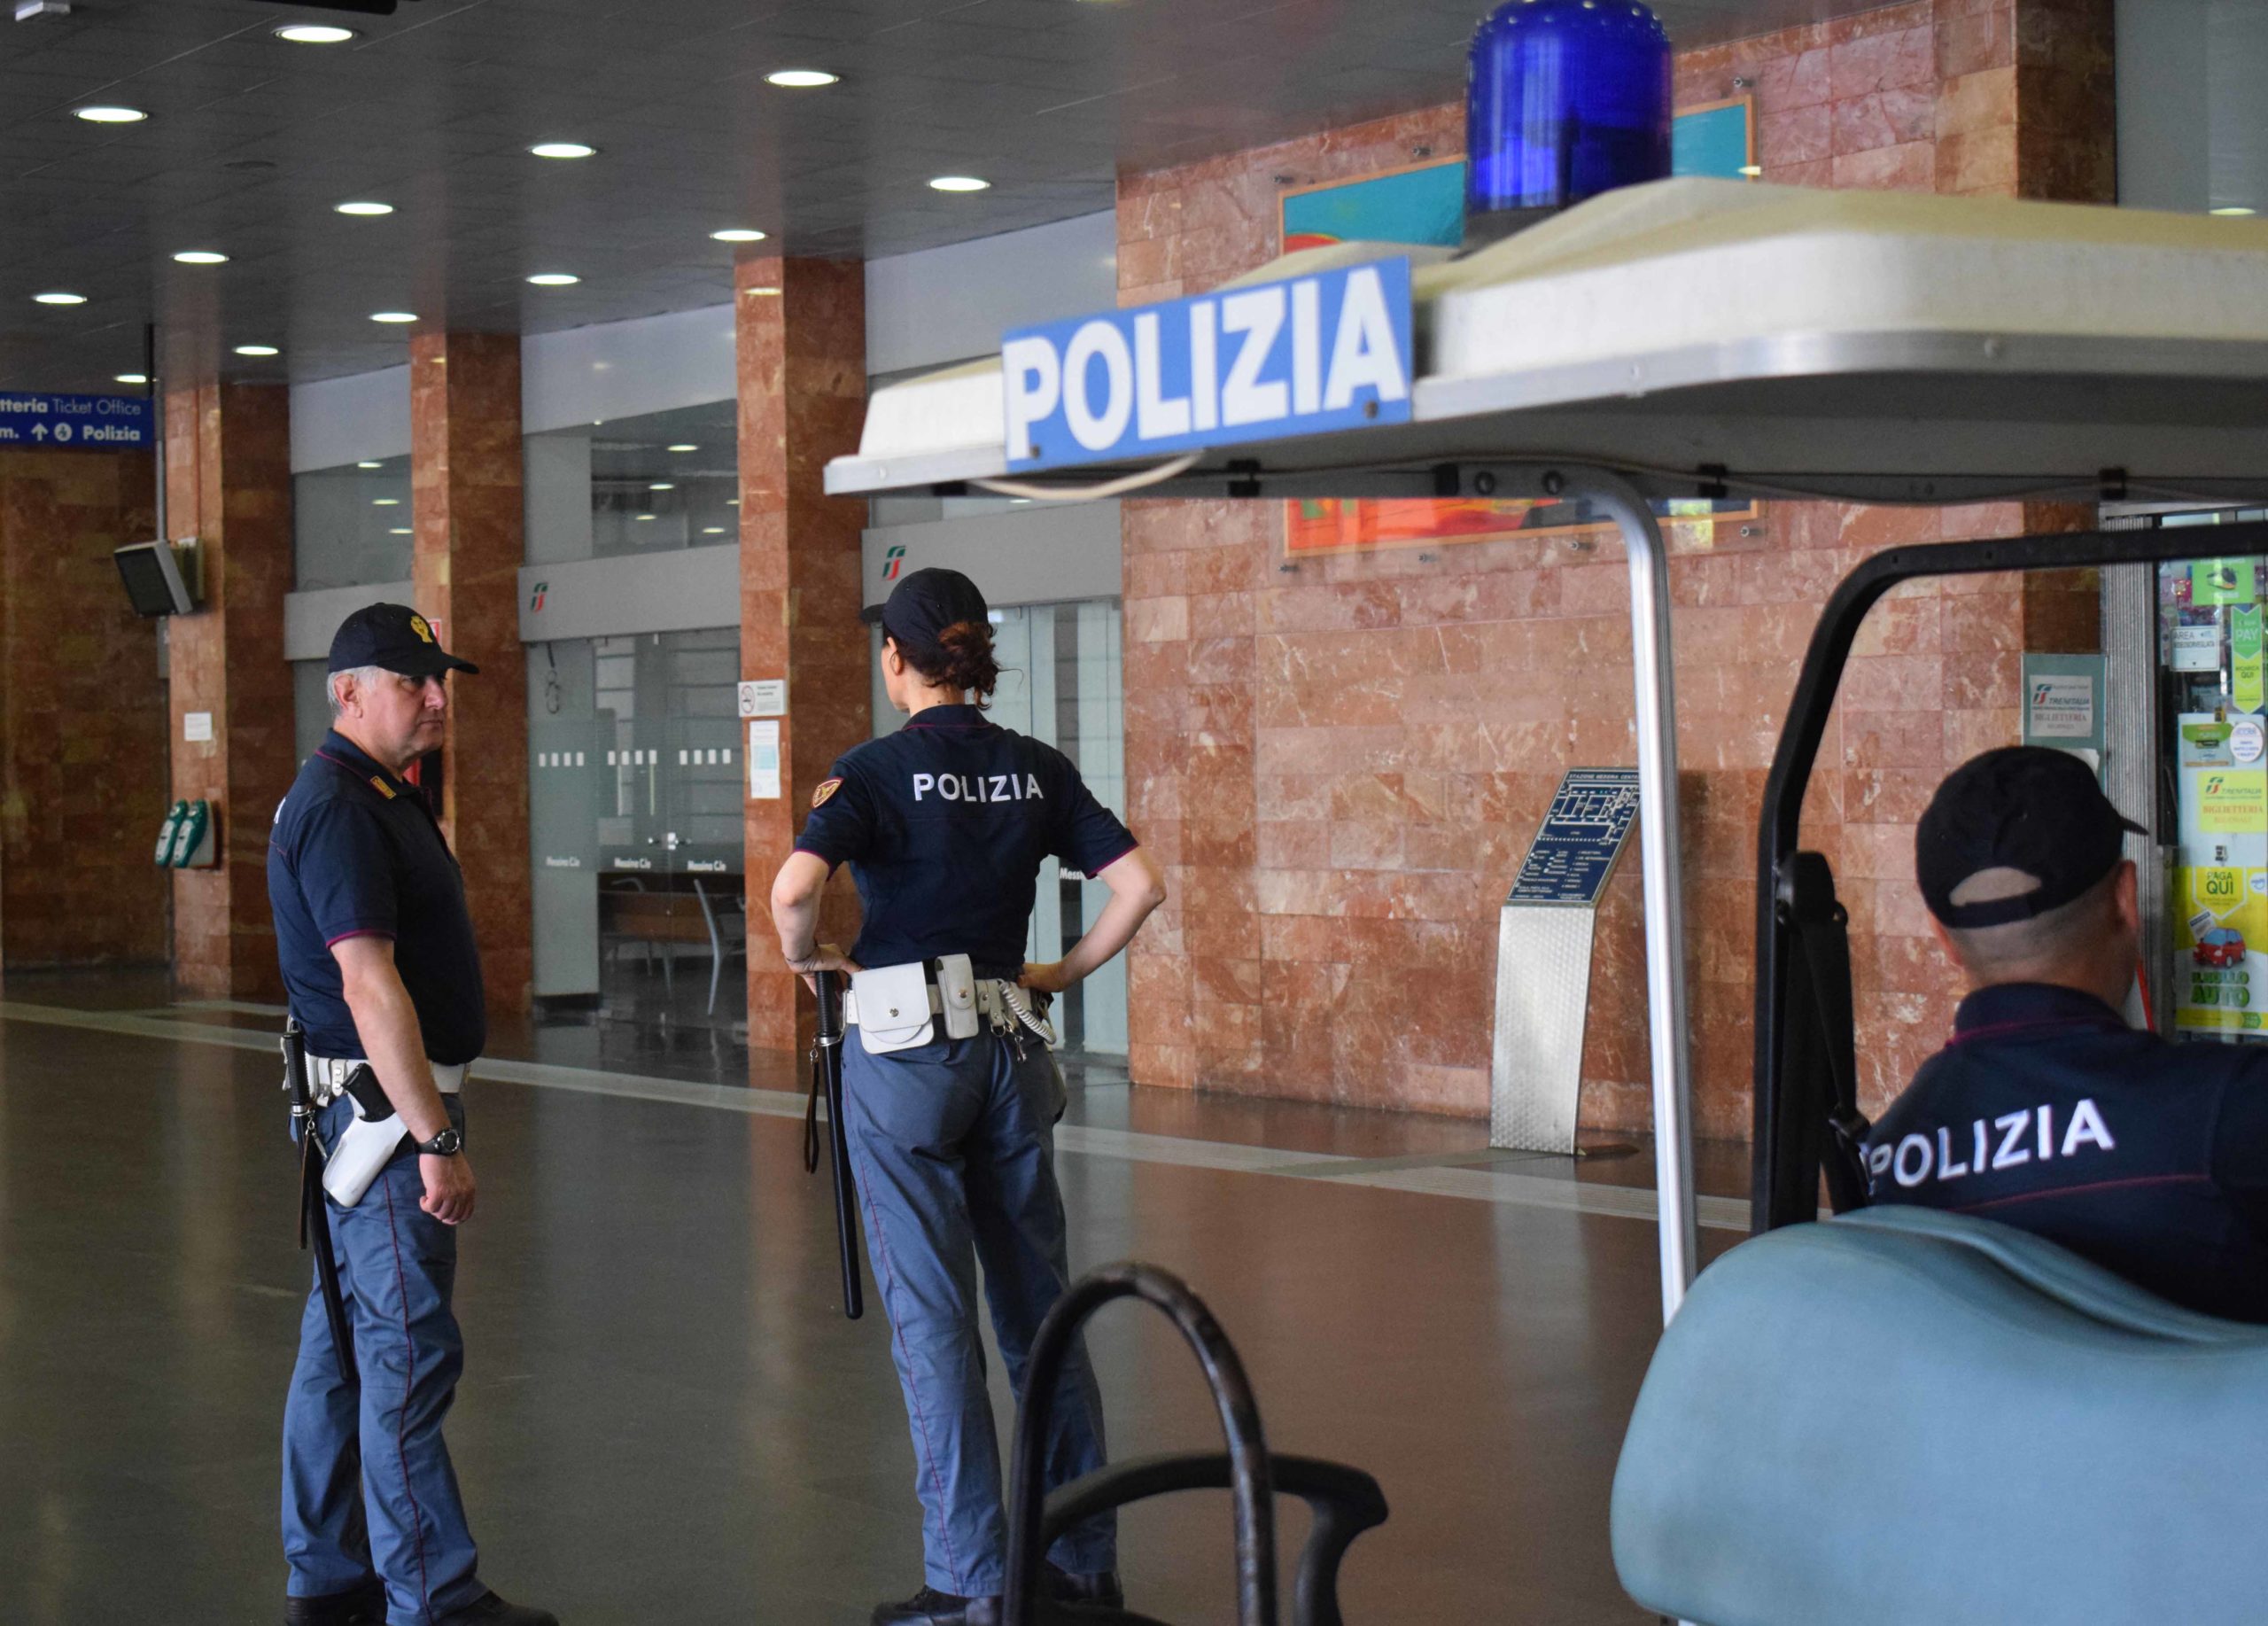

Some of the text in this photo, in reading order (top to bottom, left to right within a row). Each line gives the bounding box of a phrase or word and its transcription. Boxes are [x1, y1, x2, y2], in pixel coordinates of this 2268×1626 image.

[1003, 265, 1409, 462] POLIZIA
[0, 398, 141, 415] tteria Ticket Office
[82, 425, 141, 440] Polizia
[913, 773, 1045, 803] POLIZIA
[2206, 871, 2233, 881] PAGA
[2206, 880, 2234, 895] QUI
[2190, 984, 2250, 1008] AUTO
[1859, 1098, 2116, 1196] POLIZIA
